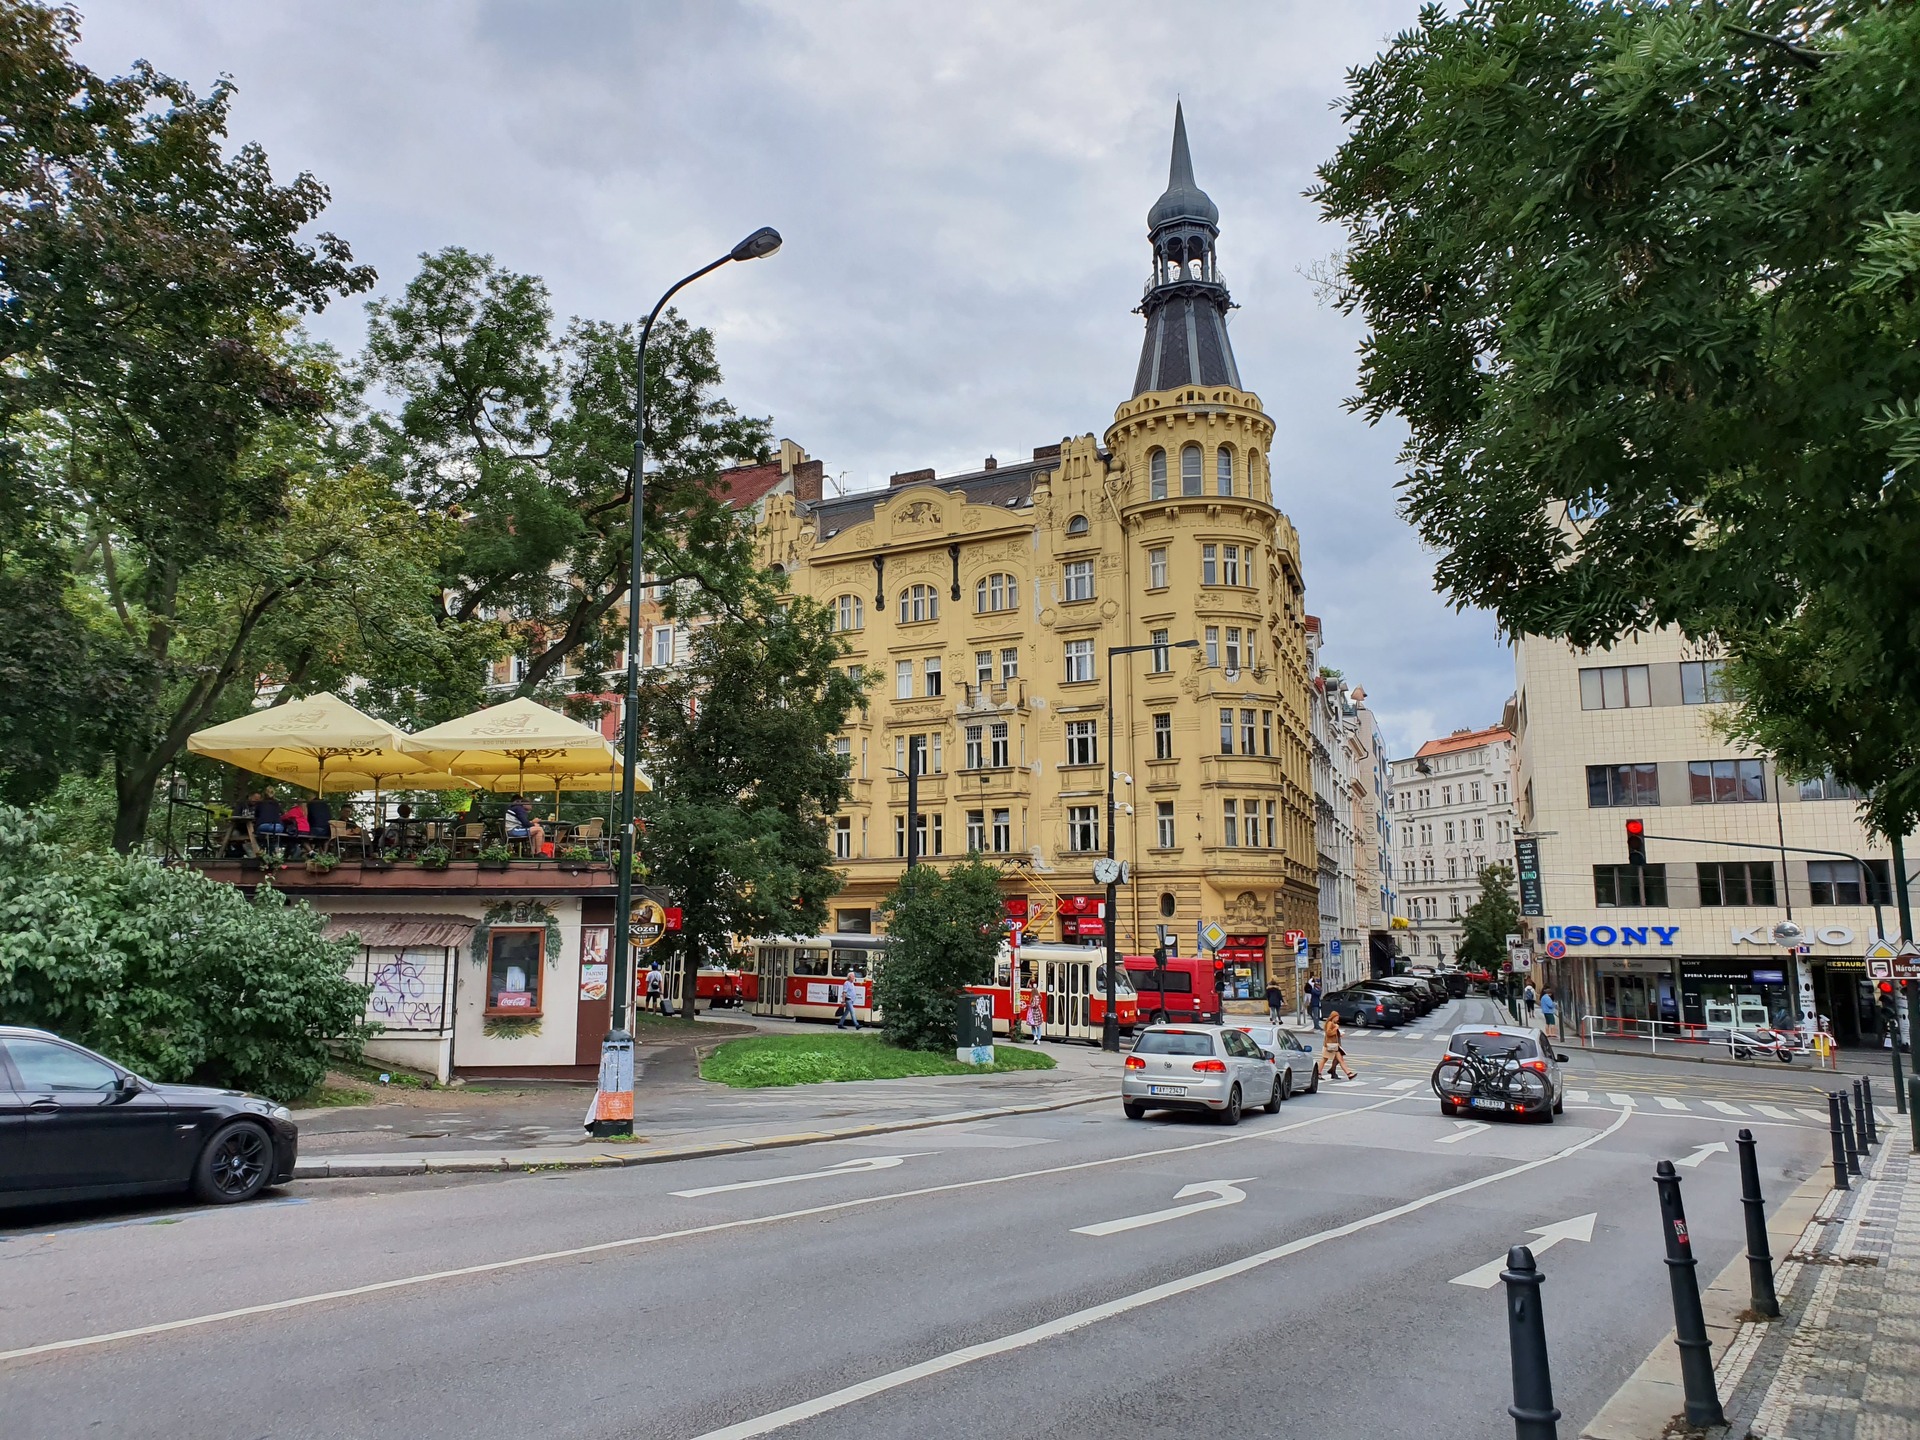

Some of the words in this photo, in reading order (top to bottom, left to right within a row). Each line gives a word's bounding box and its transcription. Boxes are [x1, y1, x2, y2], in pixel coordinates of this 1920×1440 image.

[1521, 871, 1537, 880] KINO
[628, 924, 659, 935] Kozel
[1564, 925, 1680, 946] SONY
[1895, 964, 1920, 972] Národn
[501, 997, 526, 1006] Coca-Cola
